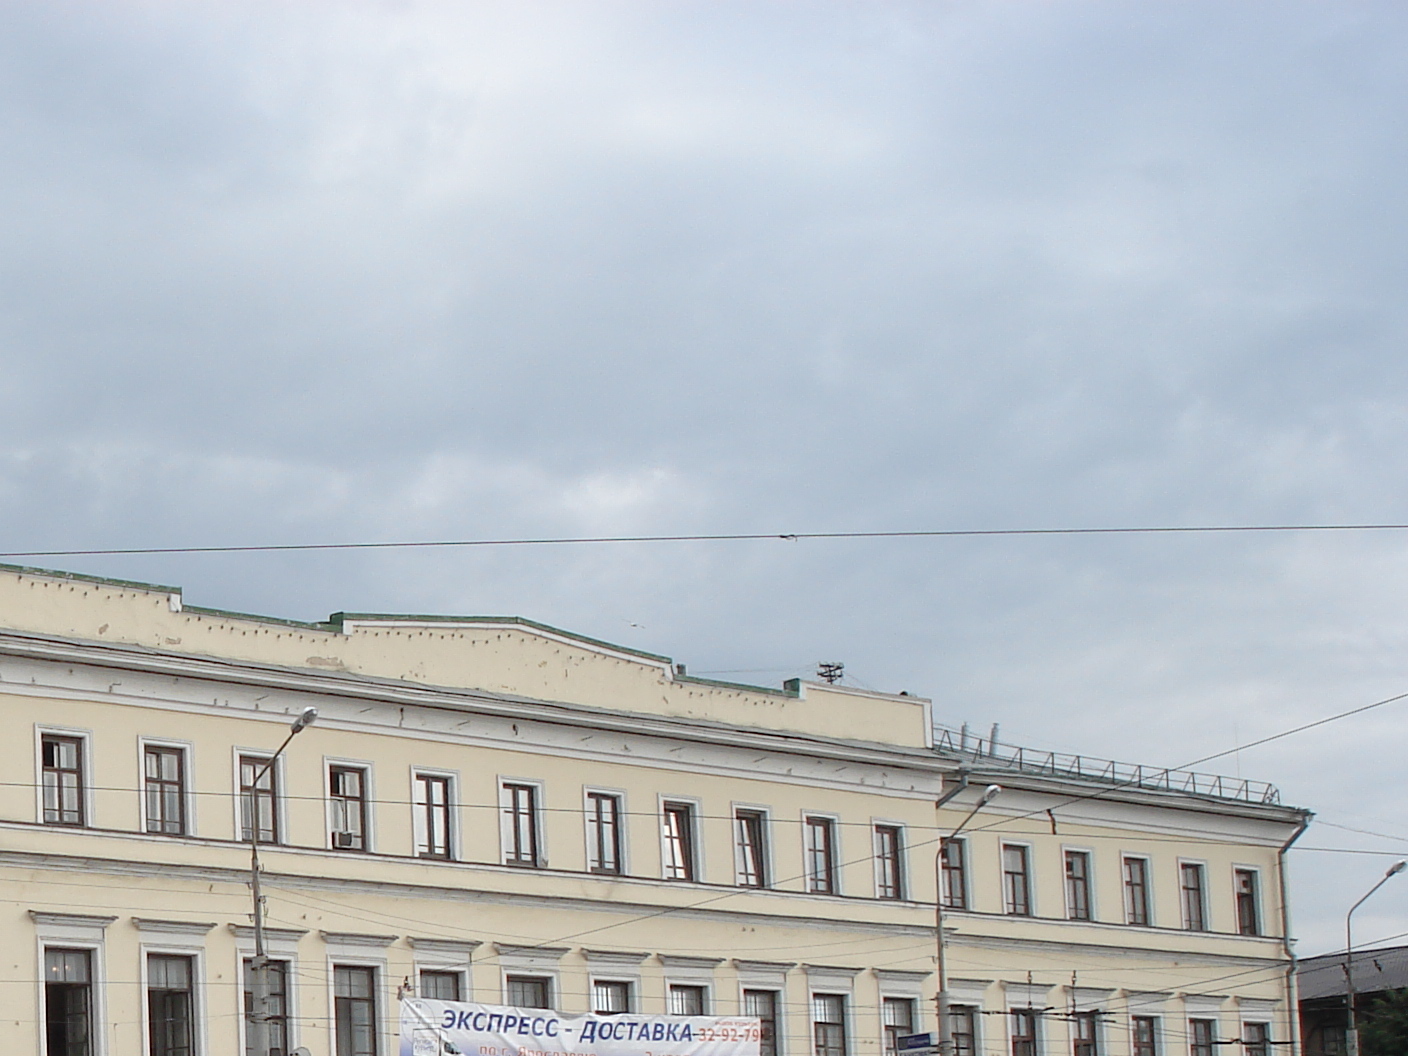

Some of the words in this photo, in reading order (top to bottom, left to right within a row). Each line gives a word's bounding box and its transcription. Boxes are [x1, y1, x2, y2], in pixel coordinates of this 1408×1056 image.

[441, 1009, 559, 1037] ЭКСПРЕСС
[579, 1020, 693, 1043] ДОСТАВКА
[698, 1028, 760, 1042] 32-92-79
[479, 1046, 496, 1056] по
